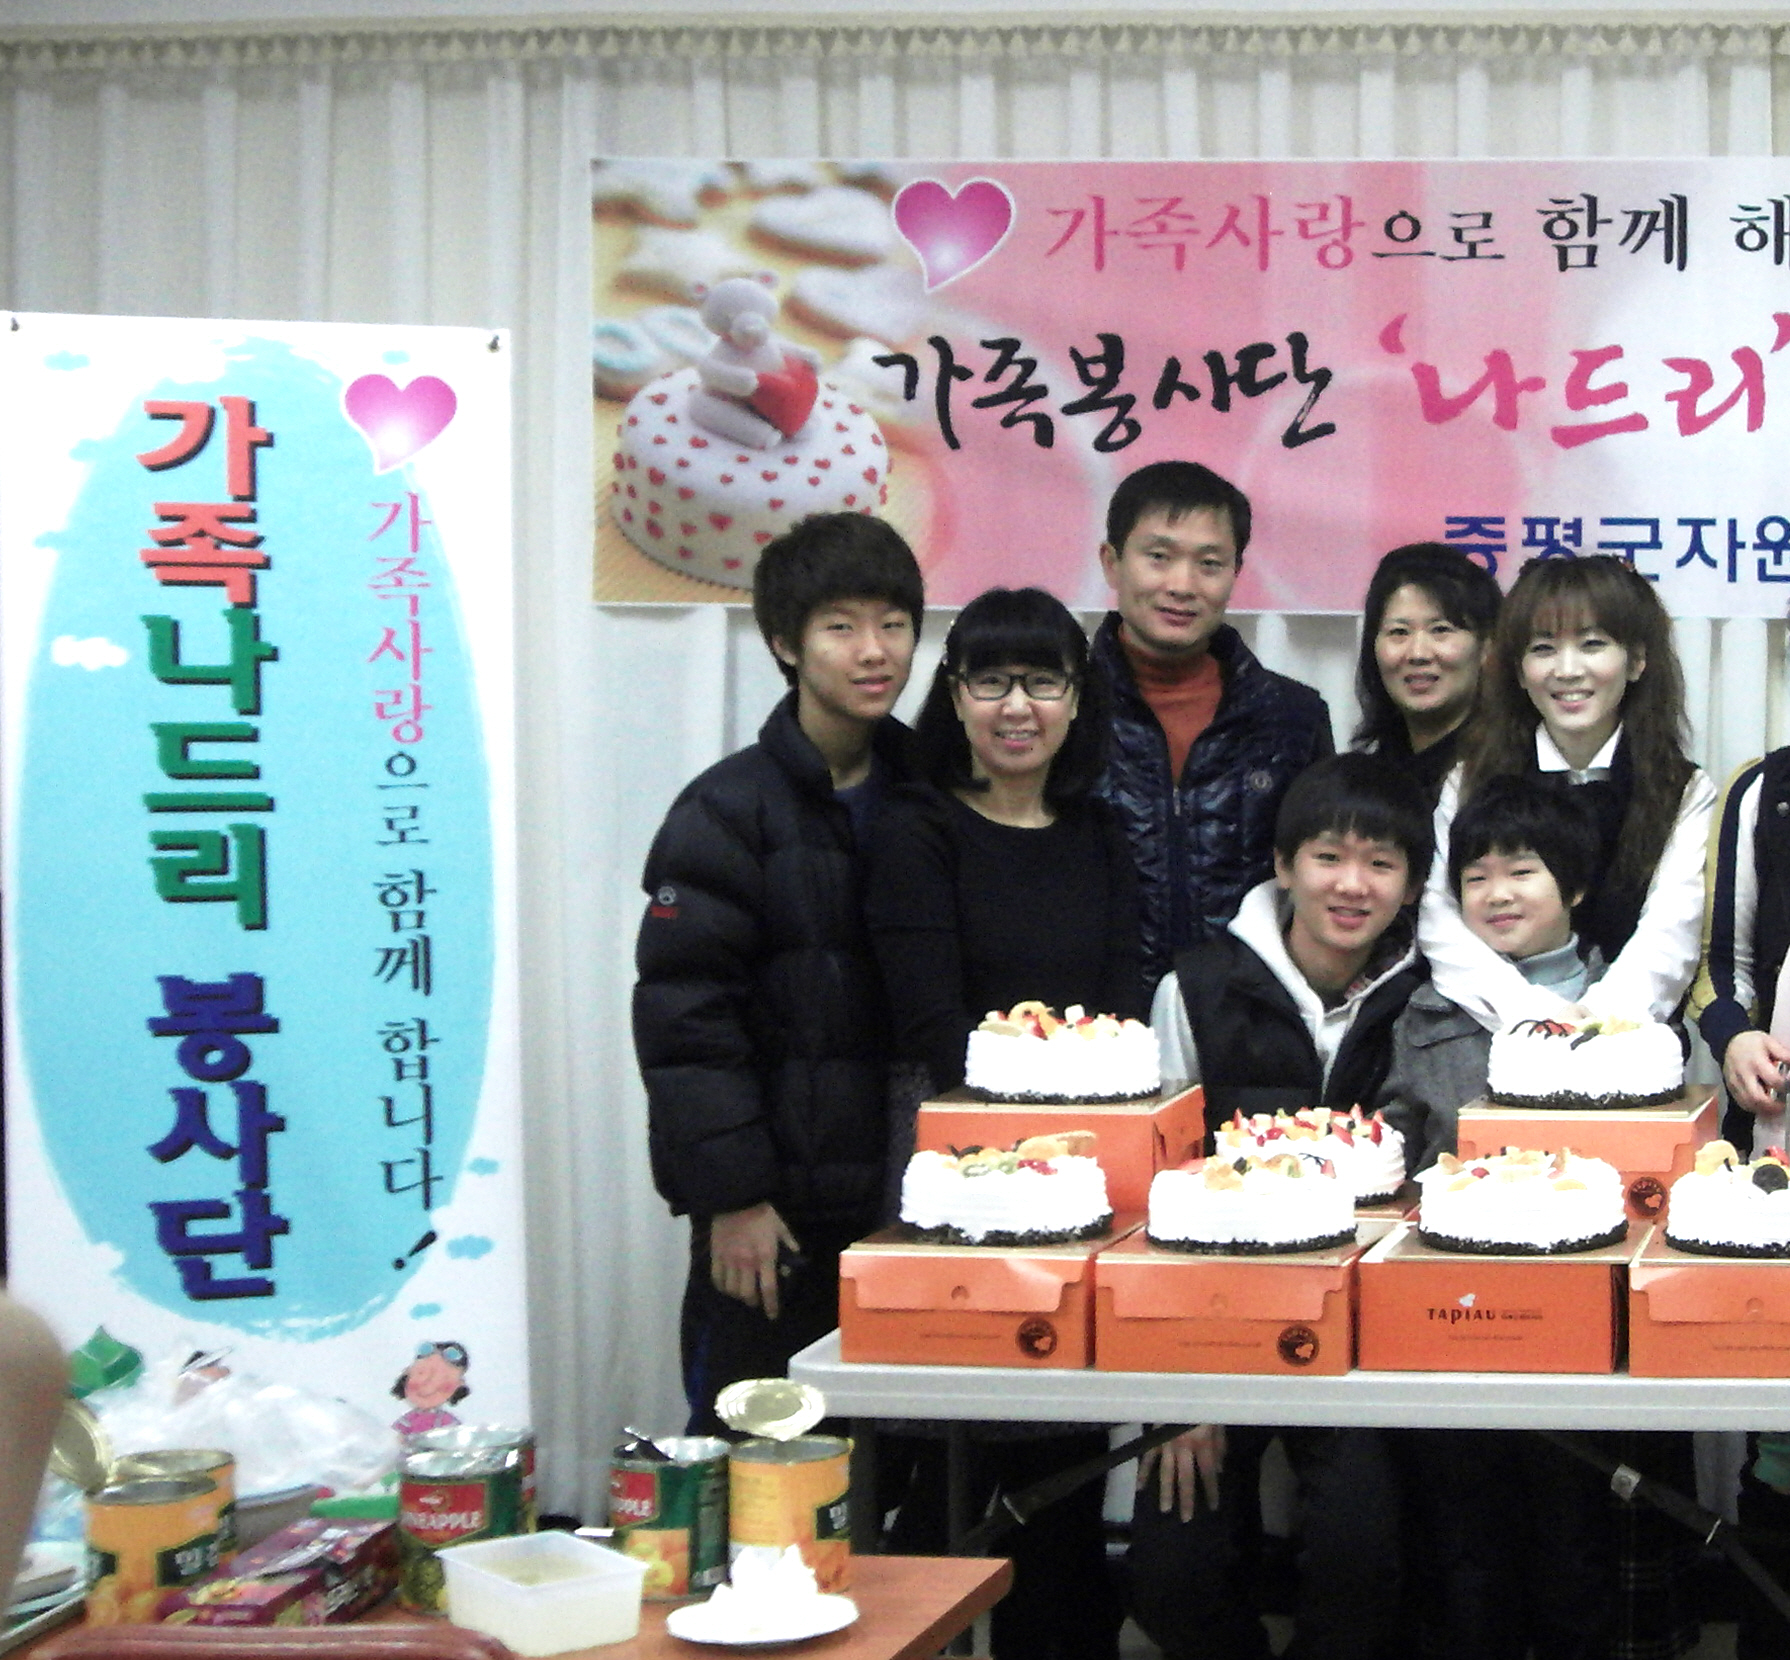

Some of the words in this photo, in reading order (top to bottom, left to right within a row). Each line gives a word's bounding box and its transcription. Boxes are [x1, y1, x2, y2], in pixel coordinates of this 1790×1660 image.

[1047, 194, 1505, 271] 가족사랑으로
[1537, 193, 1689, 272] 함께
[872, 330, 1337, 453] 가족봉사단
[135, 395, 279, 931] 가족나드리
[366, 491, 434, 846] 가족사랑으로
[372, 868, 437, 997] 함께
[145, 972, 290, 1301] 봉사단
